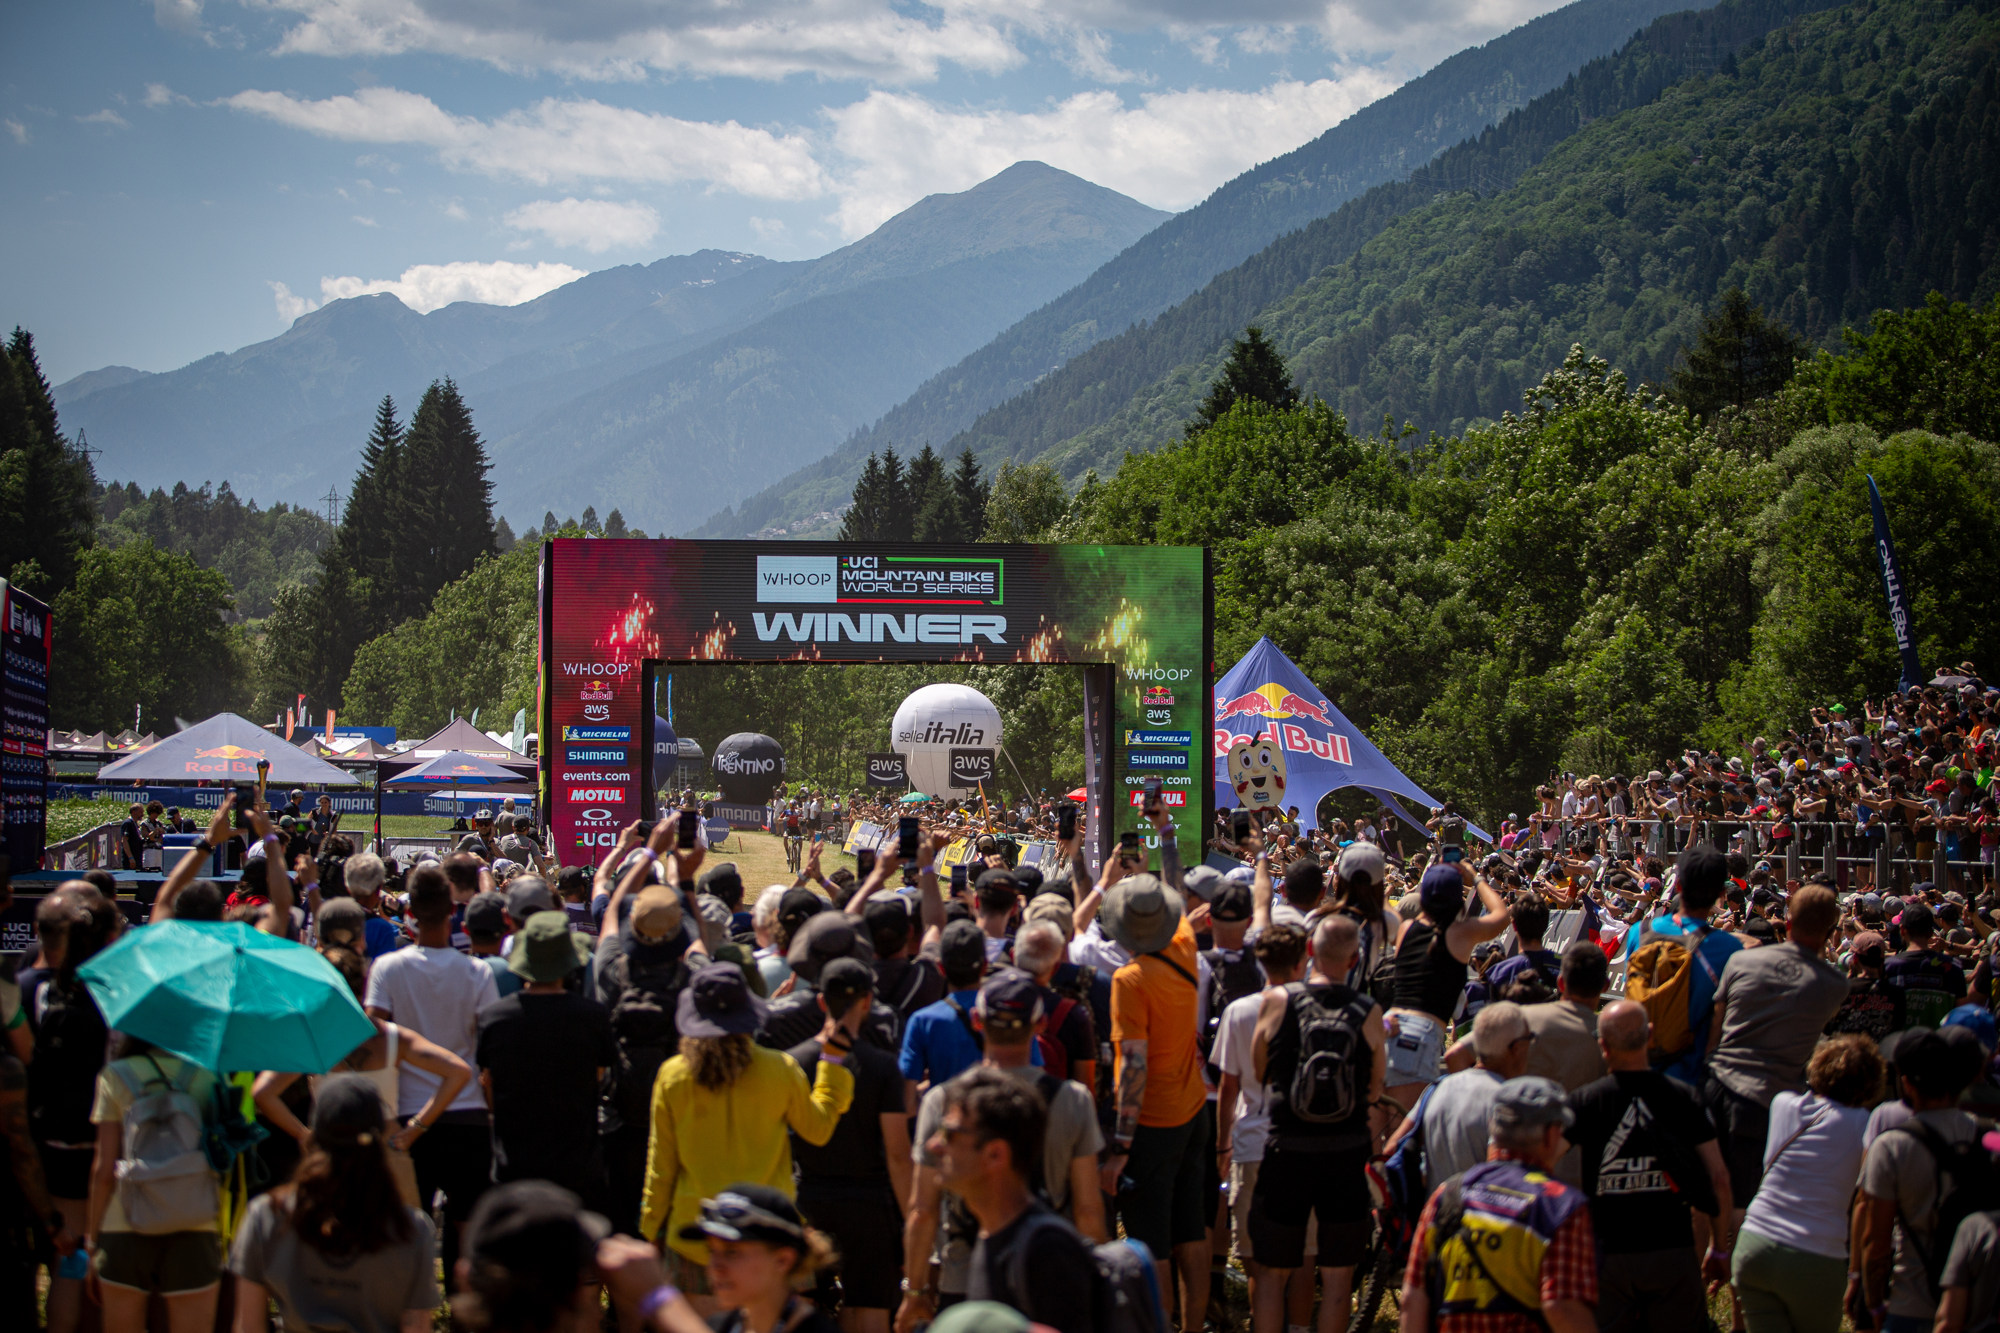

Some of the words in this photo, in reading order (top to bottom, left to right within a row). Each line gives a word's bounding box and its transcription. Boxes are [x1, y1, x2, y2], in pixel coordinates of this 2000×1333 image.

[849, 556, 878, 568] UCI
[763, 572, 831, 586] WHOOP
[842, 570, 945, 582] MOUNTAIN
[950, 571, 994, 582] BIKE
[842, 582, 917, 593] WORLD
[923, 583, 994, 594] SERIES
[752, 612, 1007, 643] WINNER
[563, 663, 630, 675] WHOOP
[1126, 668, 1192, 680] WHOOP
[584, 704, 609, 714] aws
[1147, 710, 1171, 718] aws
[1283, 723, 1353, 766] Bull
[569, 752, 624, 760] SHIMANO
[1131, 755, 1185, 764] SHIMANO
[185, 761, 228, 772] Red
[232, 761, 273, 774] Bul
[718, 754, 774, 775] TRENTINO
[870, 760, 902, 772] aws
[954, 756, 990, 770] aws
[563, 772, 630, 781] events.com
[571, 790, 622, 801] MOTUL
[584, 833, 616, 846] UCI
